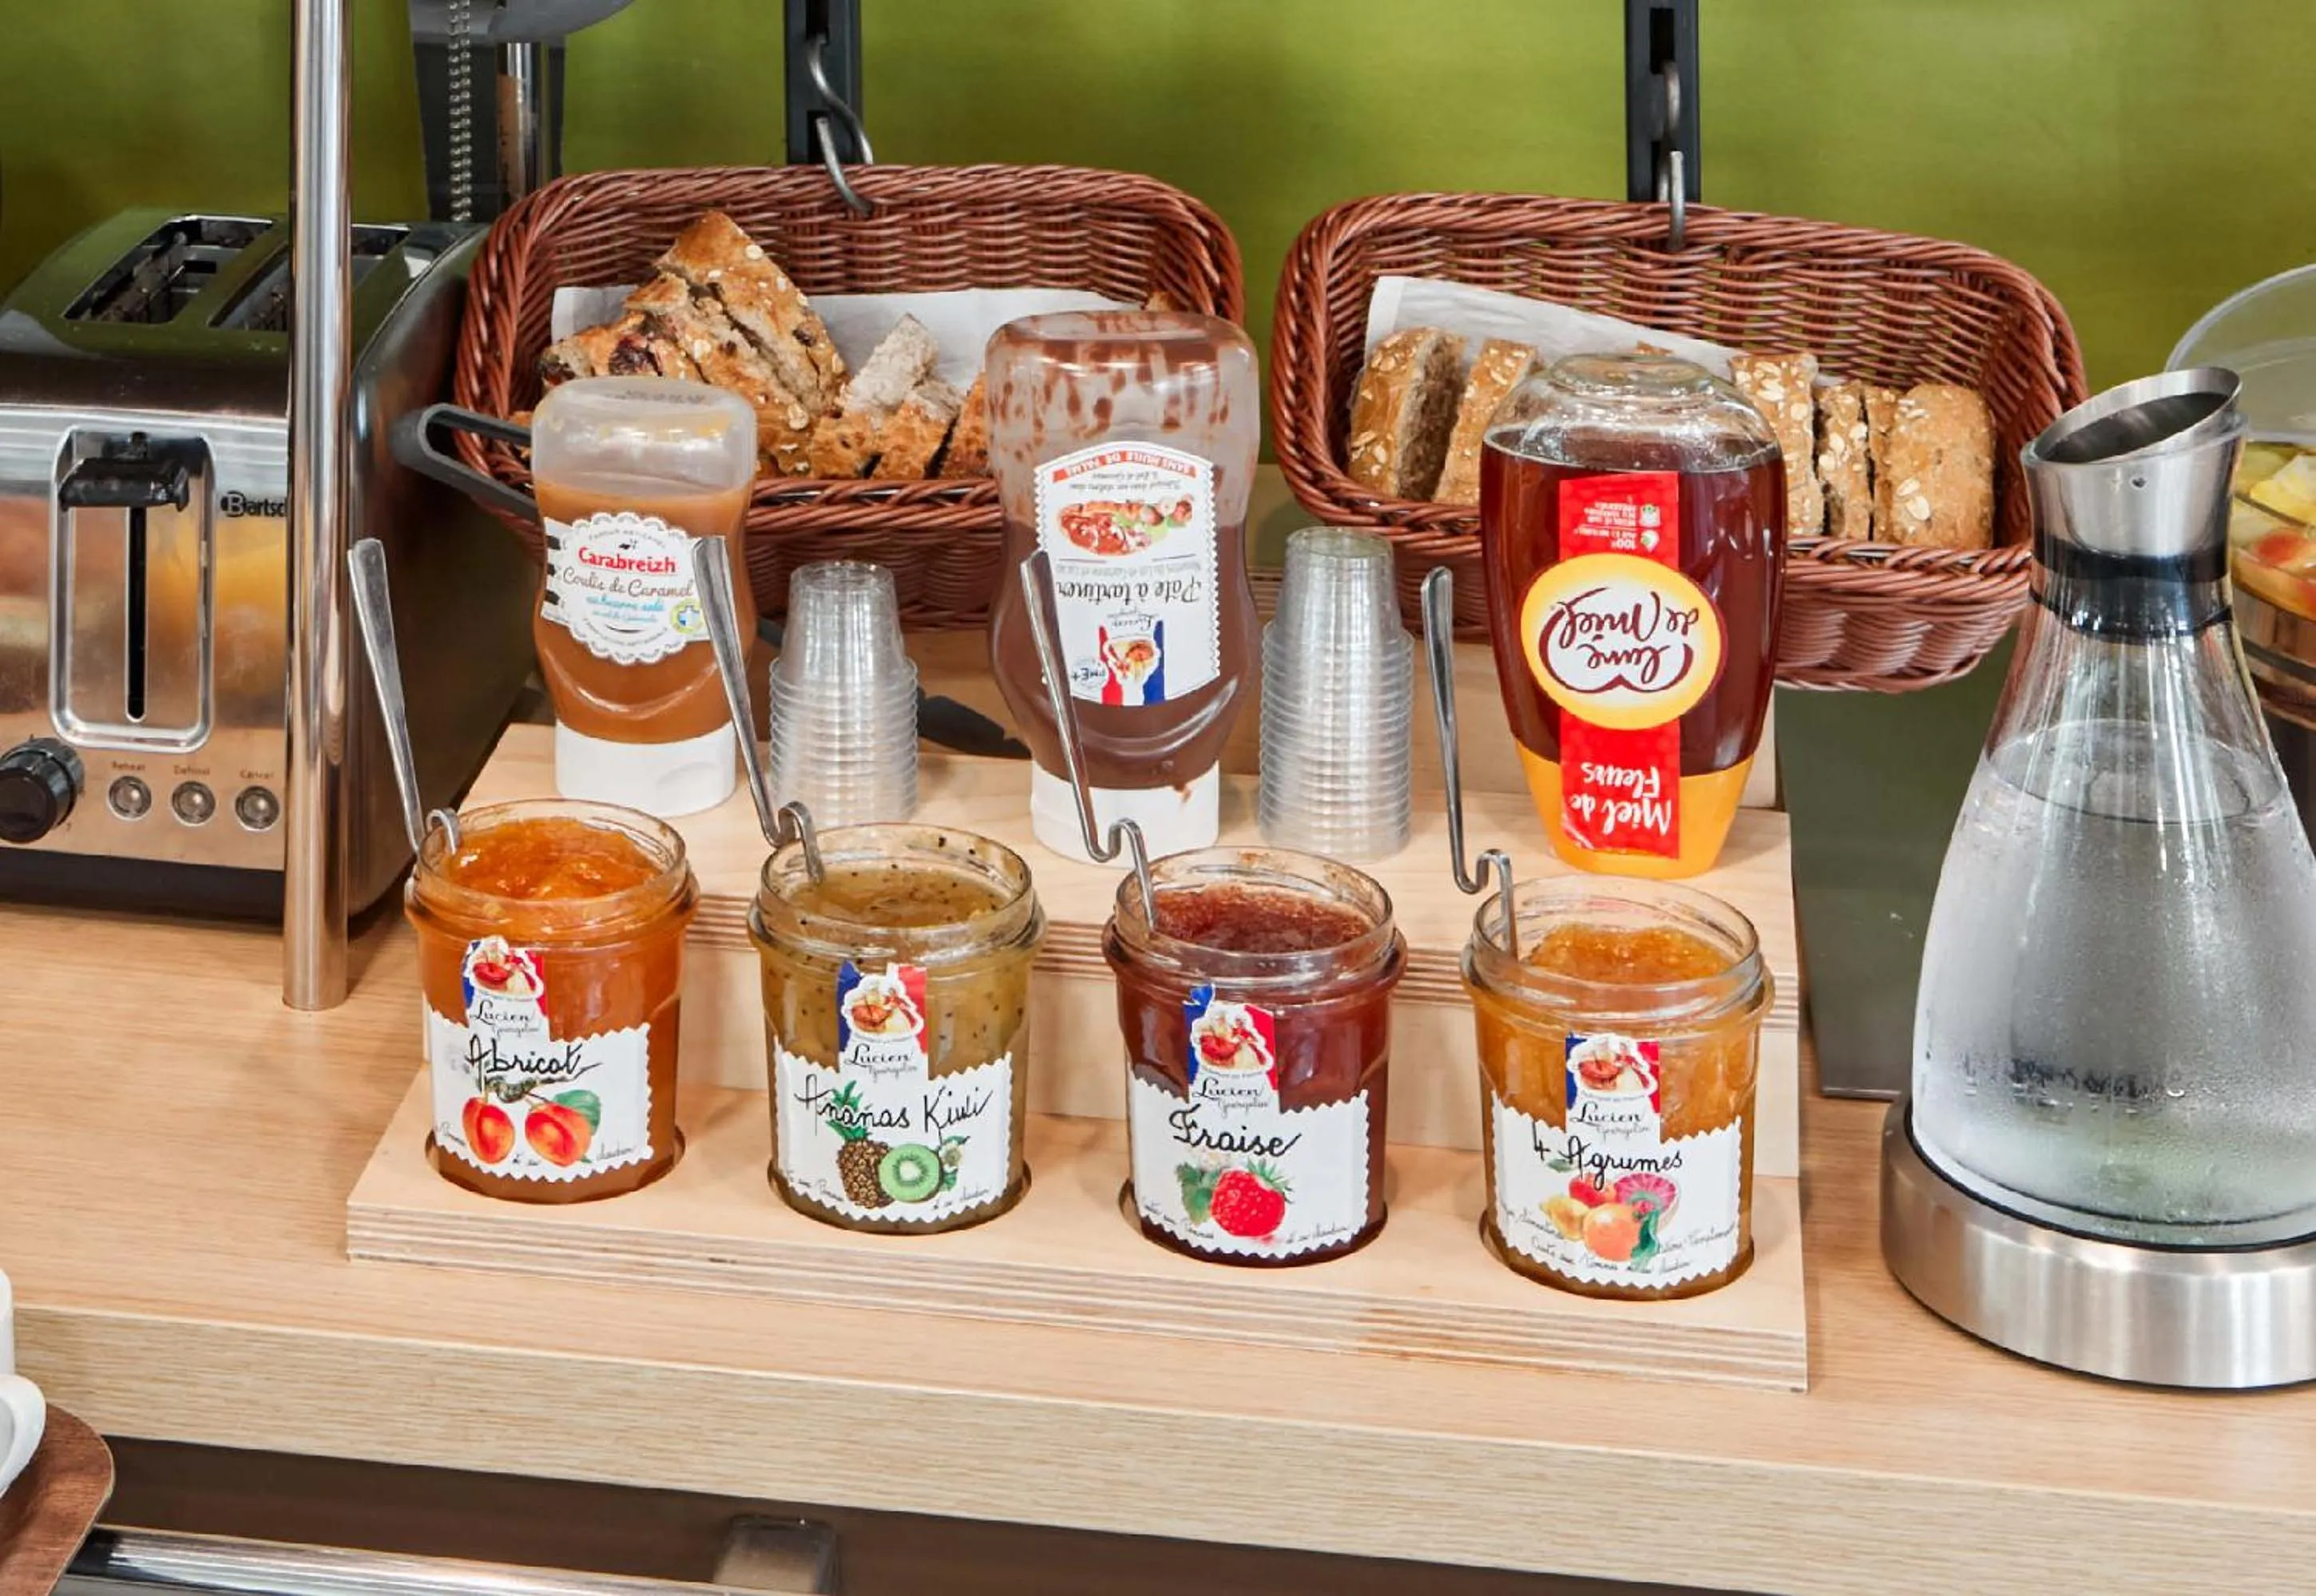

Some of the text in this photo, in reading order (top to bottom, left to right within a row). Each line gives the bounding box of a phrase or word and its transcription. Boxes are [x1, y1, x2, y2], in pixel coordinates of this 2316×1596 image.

[578, 546, 676, 573] Carabreizh
[609, 576, 625, 593] de
[1056, 575, 1202, 605] Pâte à tartiner
[1664, 604, 1699, 639] de
[1580, 762, 1661, 799] Fleurs
[1569, 794, 1672, 837] Miel de
[470, 1000, 533, 1025] Lucien
[464, 1034, 604, 1078] Abricot
[844, 1044, 914, 1067] Lucien
[794, 1074, 993, 1135] Ananas Kiwi
[1192, 1077, 1264, 1100] Lucien
[1168, 1103, 1303, 1157] Fraise
[1570, 1102, 1647, 1127] Lucien
[1532, 1123, 1683, 1190] 4 Agrumes
